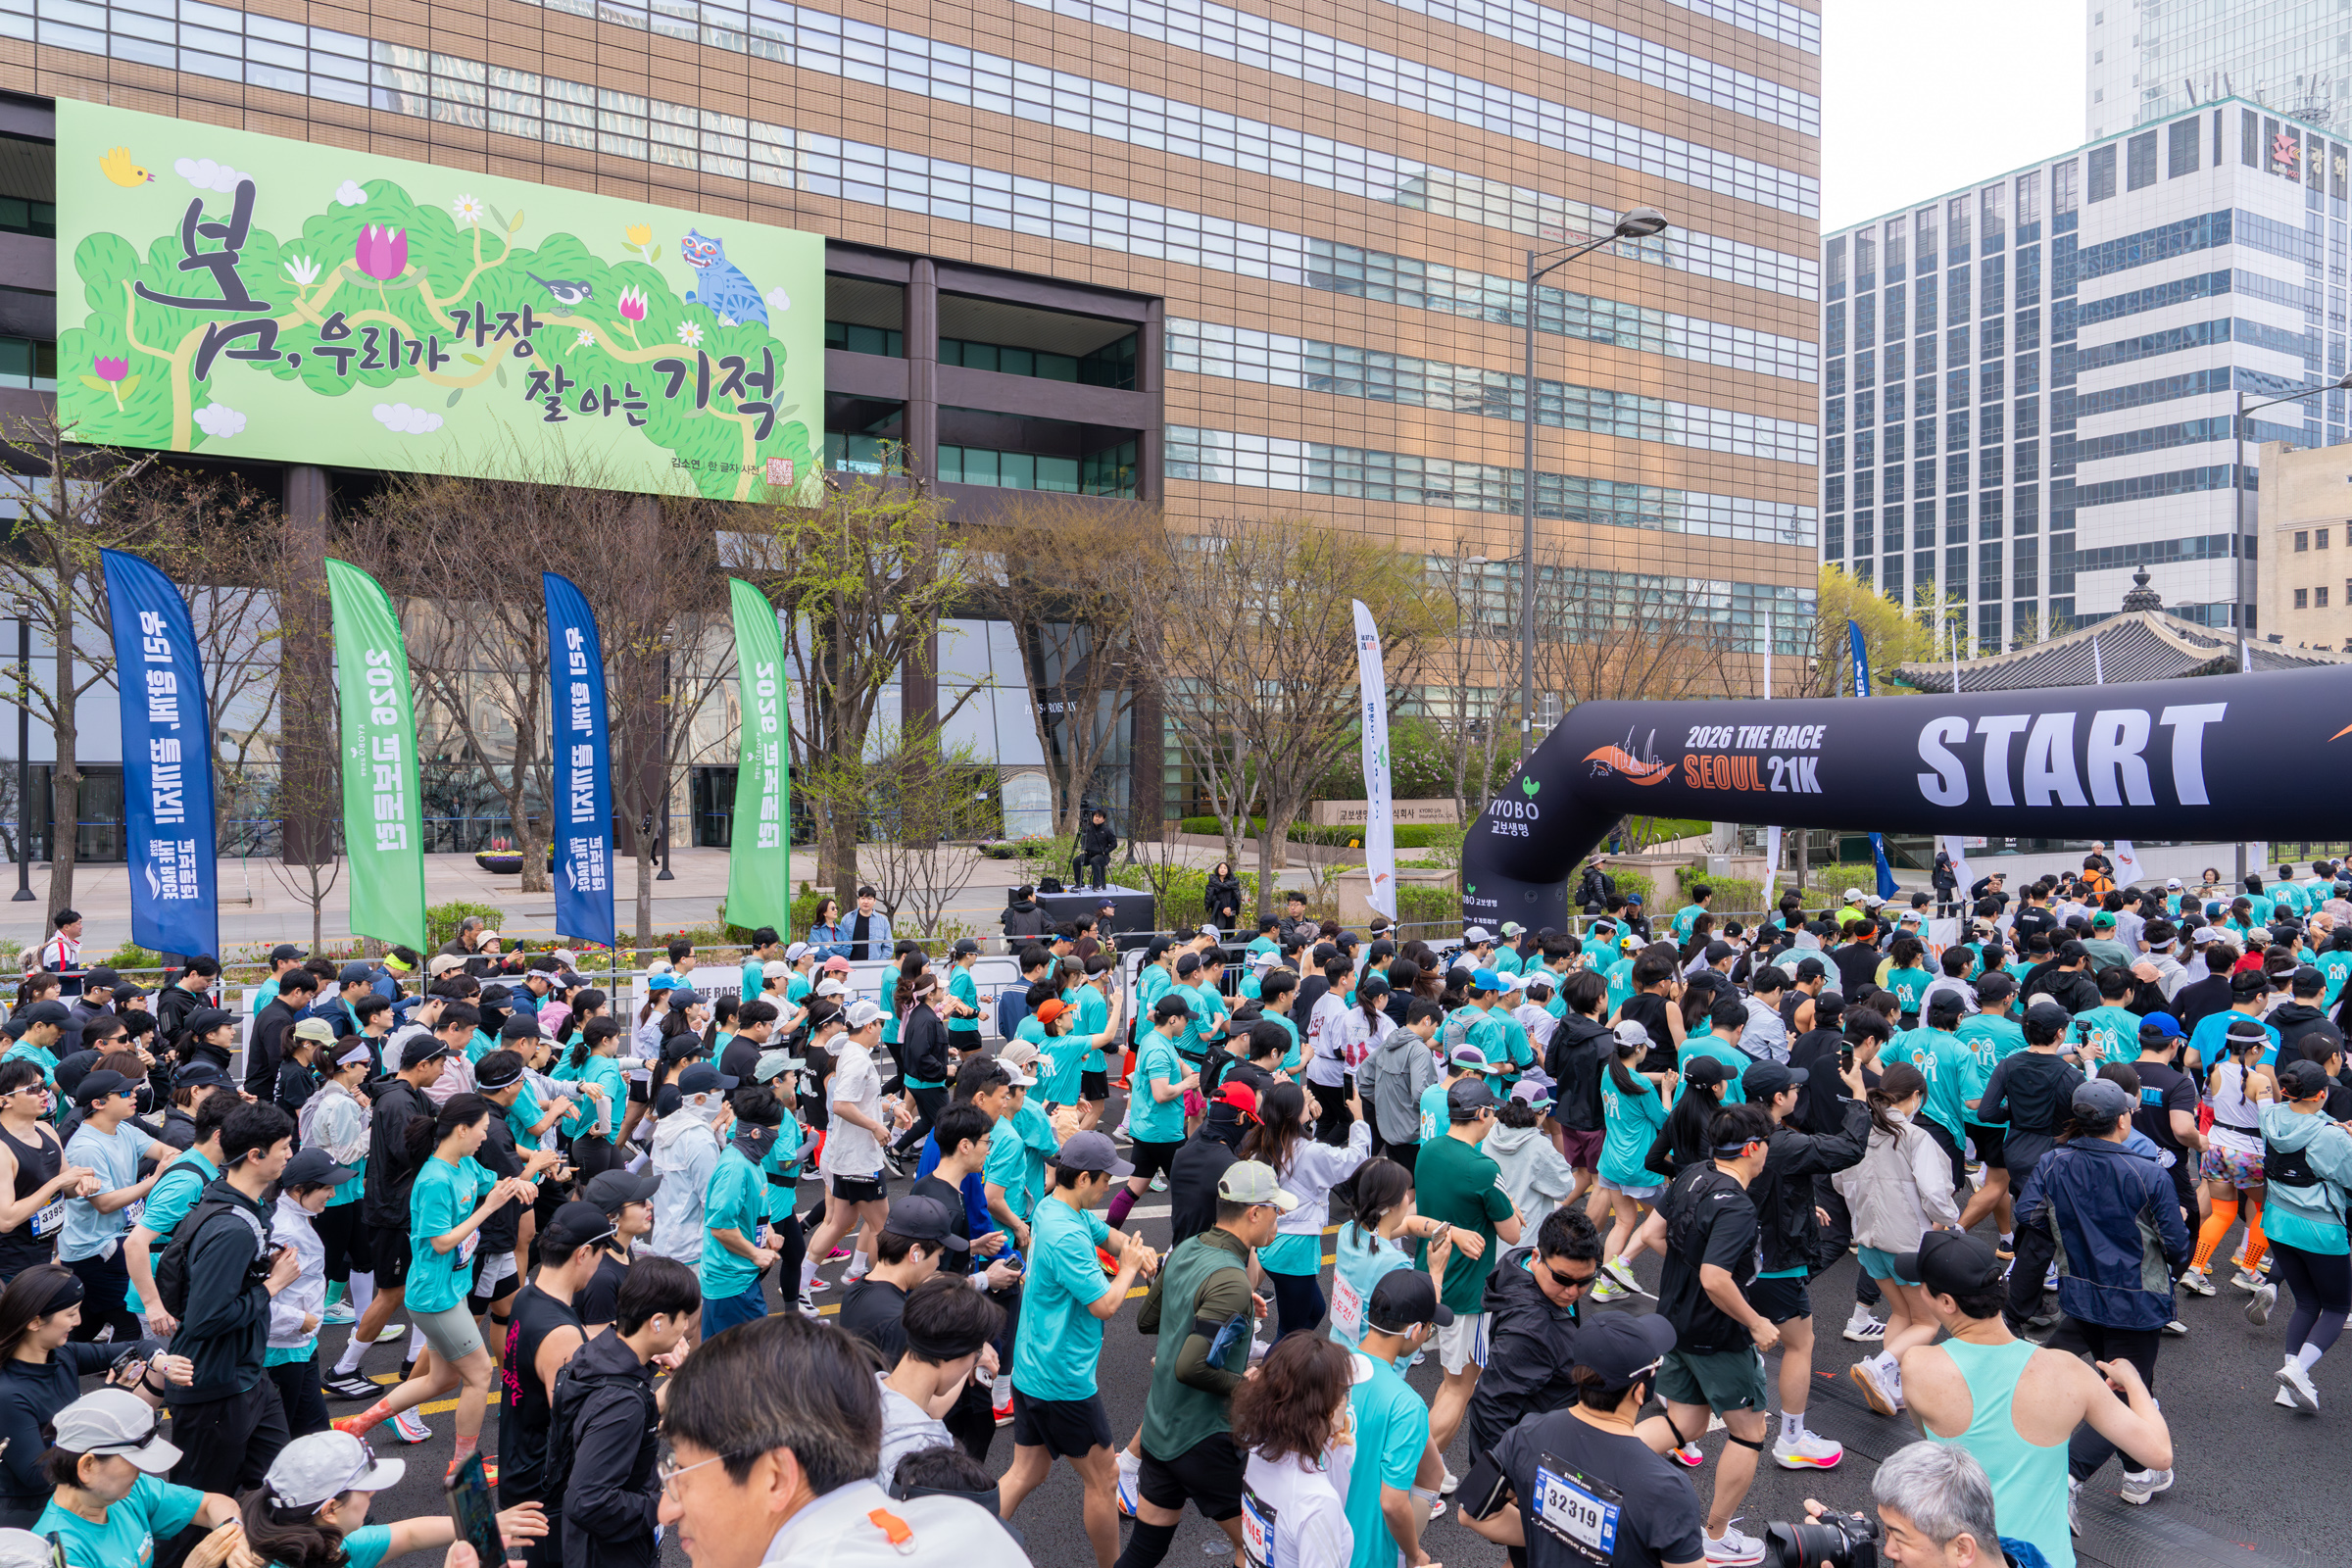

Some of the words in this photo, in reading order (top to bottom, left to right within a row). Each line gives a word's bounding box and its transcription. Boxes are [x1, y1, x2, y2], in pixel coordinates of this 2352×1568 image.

[133, 178, 302, 382] 봄,
[312, 311, 451, 376] 우리가
[449, 300, 544, 358] 가장
[524, 364, 575, 422] 잘
[579, 382, 649, 427] 아는
[652, 346, 776, 441] 기적
[671, 458, 701, 469] 김소연
[708, 461, 717, 471] 한
[719, 463, 739, 473] 글자
[741, 466, 760, 475] 사전
[1024, 703, 1044, 715] PAS
[1685, 725, 1735, 749] 2026
[1736, 725, 1773, 749] THE
[1771, 725, 1827, 750] RACE
[1917, 702, 2229, 807] START
[1684, 754, 1766, 791] SEOUL
[1767, 756, 1823, 793] 21K
[1489, 799, 1540, 820] KYOBO
[1492, 820, 1530, 838] 교보생명
[1476, 898, 1497, 907] 교보생명
[713, 986, 742, 999] RACE
[42, 1202, 65, 1223] 3395
[32, 1219, 38, 1228] C
[1536, 1485, 1544, 1500] B
[1549, 1489, 1597, 1529] 32319
[1603, 1523, 1613, 1539] B
